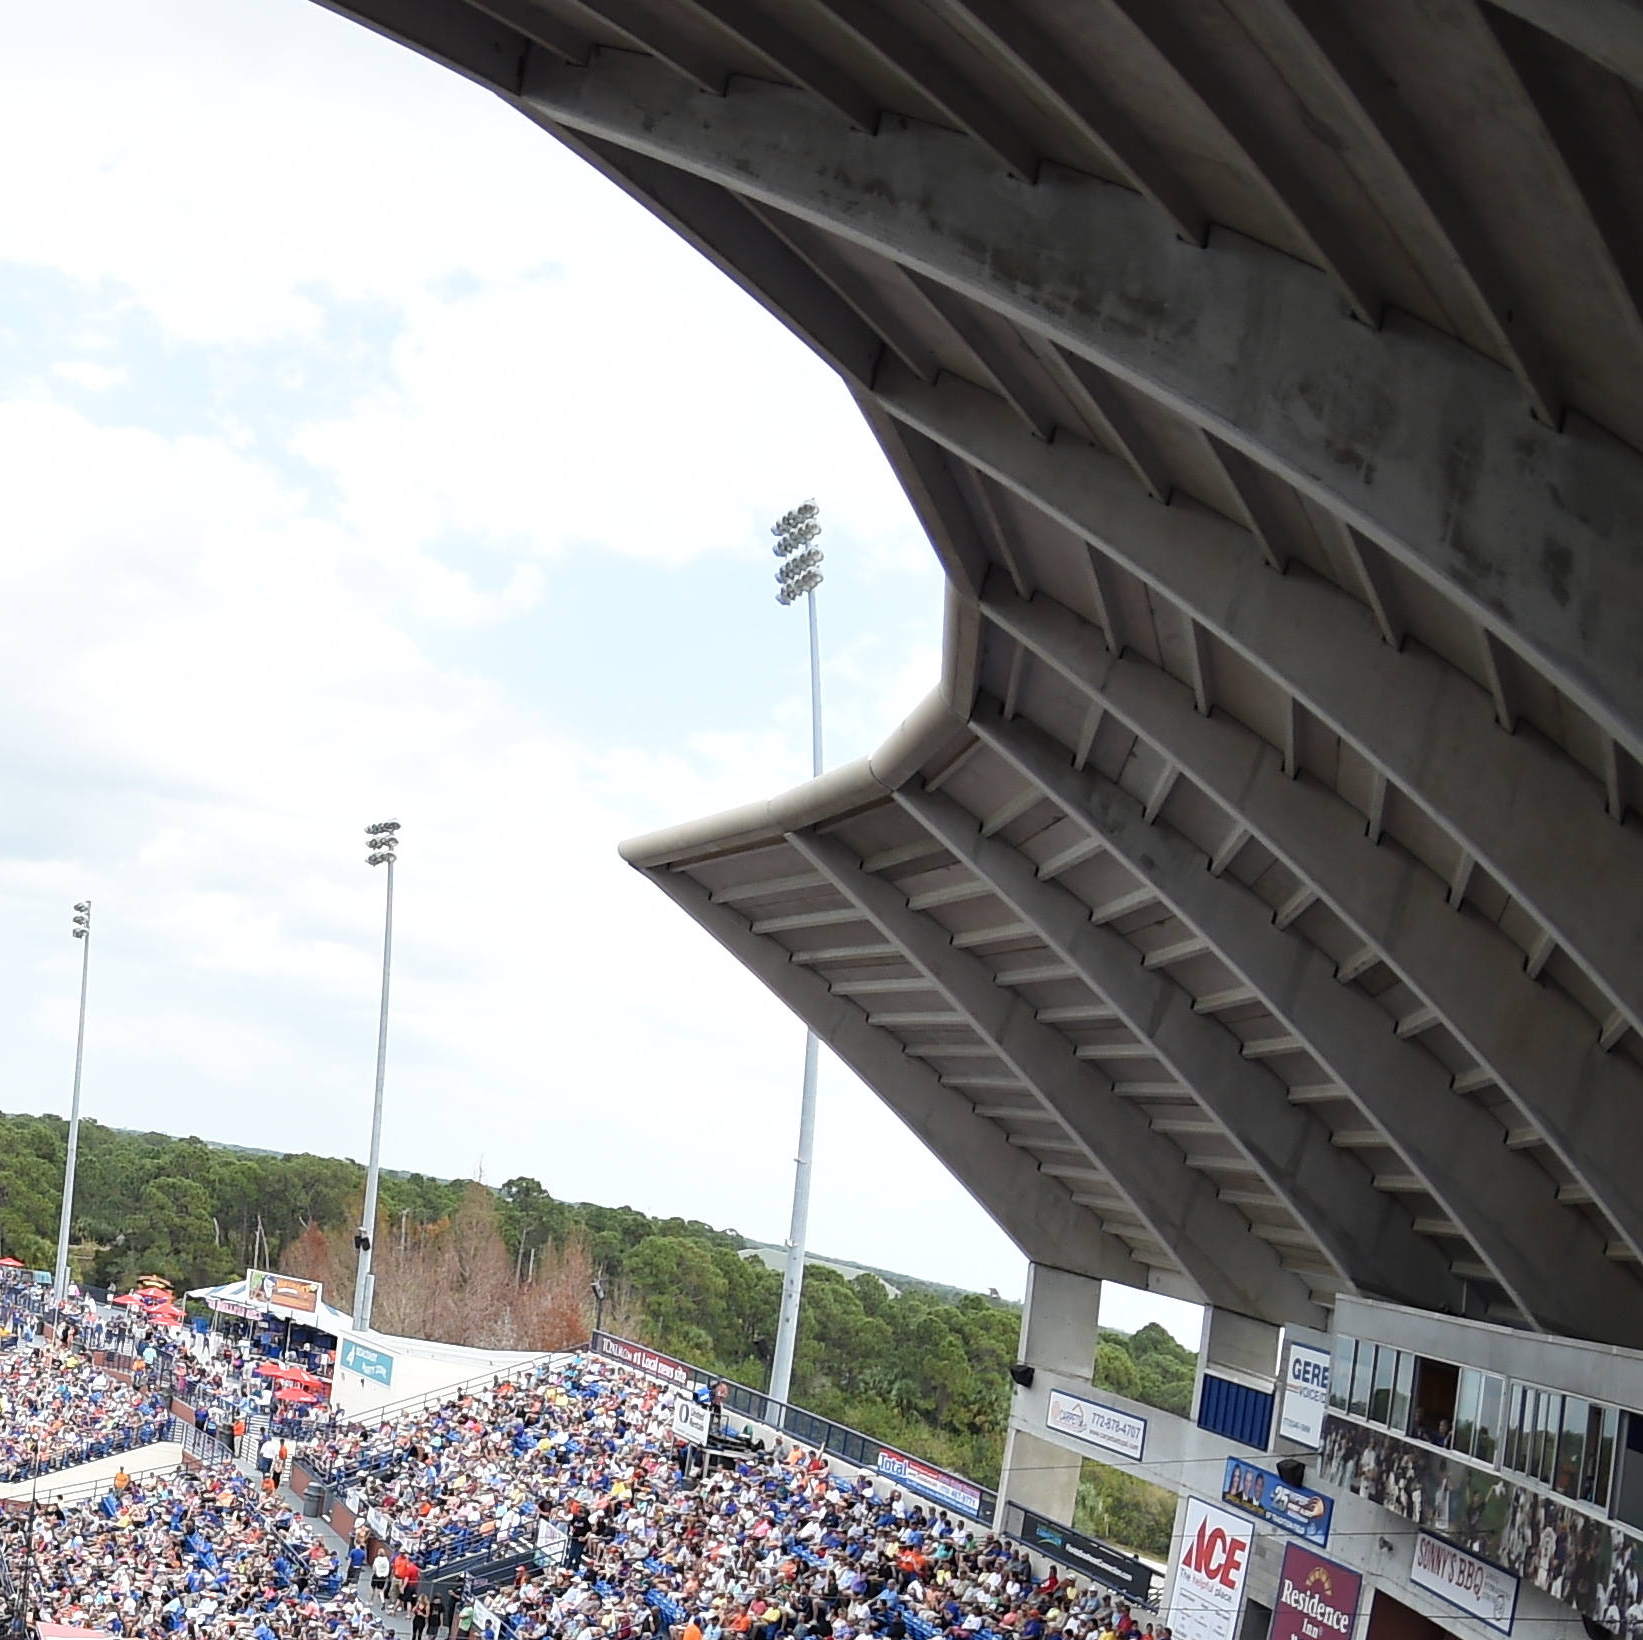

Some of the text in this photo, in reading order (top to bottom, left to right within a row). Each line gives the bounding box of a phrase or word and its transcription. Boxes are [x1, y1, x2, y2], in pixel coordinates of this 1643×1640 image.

[642, 1352, 658, 1373] Local
[880, 1453, 907, 1476] Total
[1182, 1514, 1247, 1590] ACE
[1180, 1567, 1191, 1582] The
[1192, 1575, 1214, 1593] helpful
[1417, 1538, 1458, 1585] SONNY'S
[1455, 1557, 1484, 1602] BBQ
[1281, 1579, 1349, 1633] Residence
[1302, 1618, 1319, 1640] Inn
